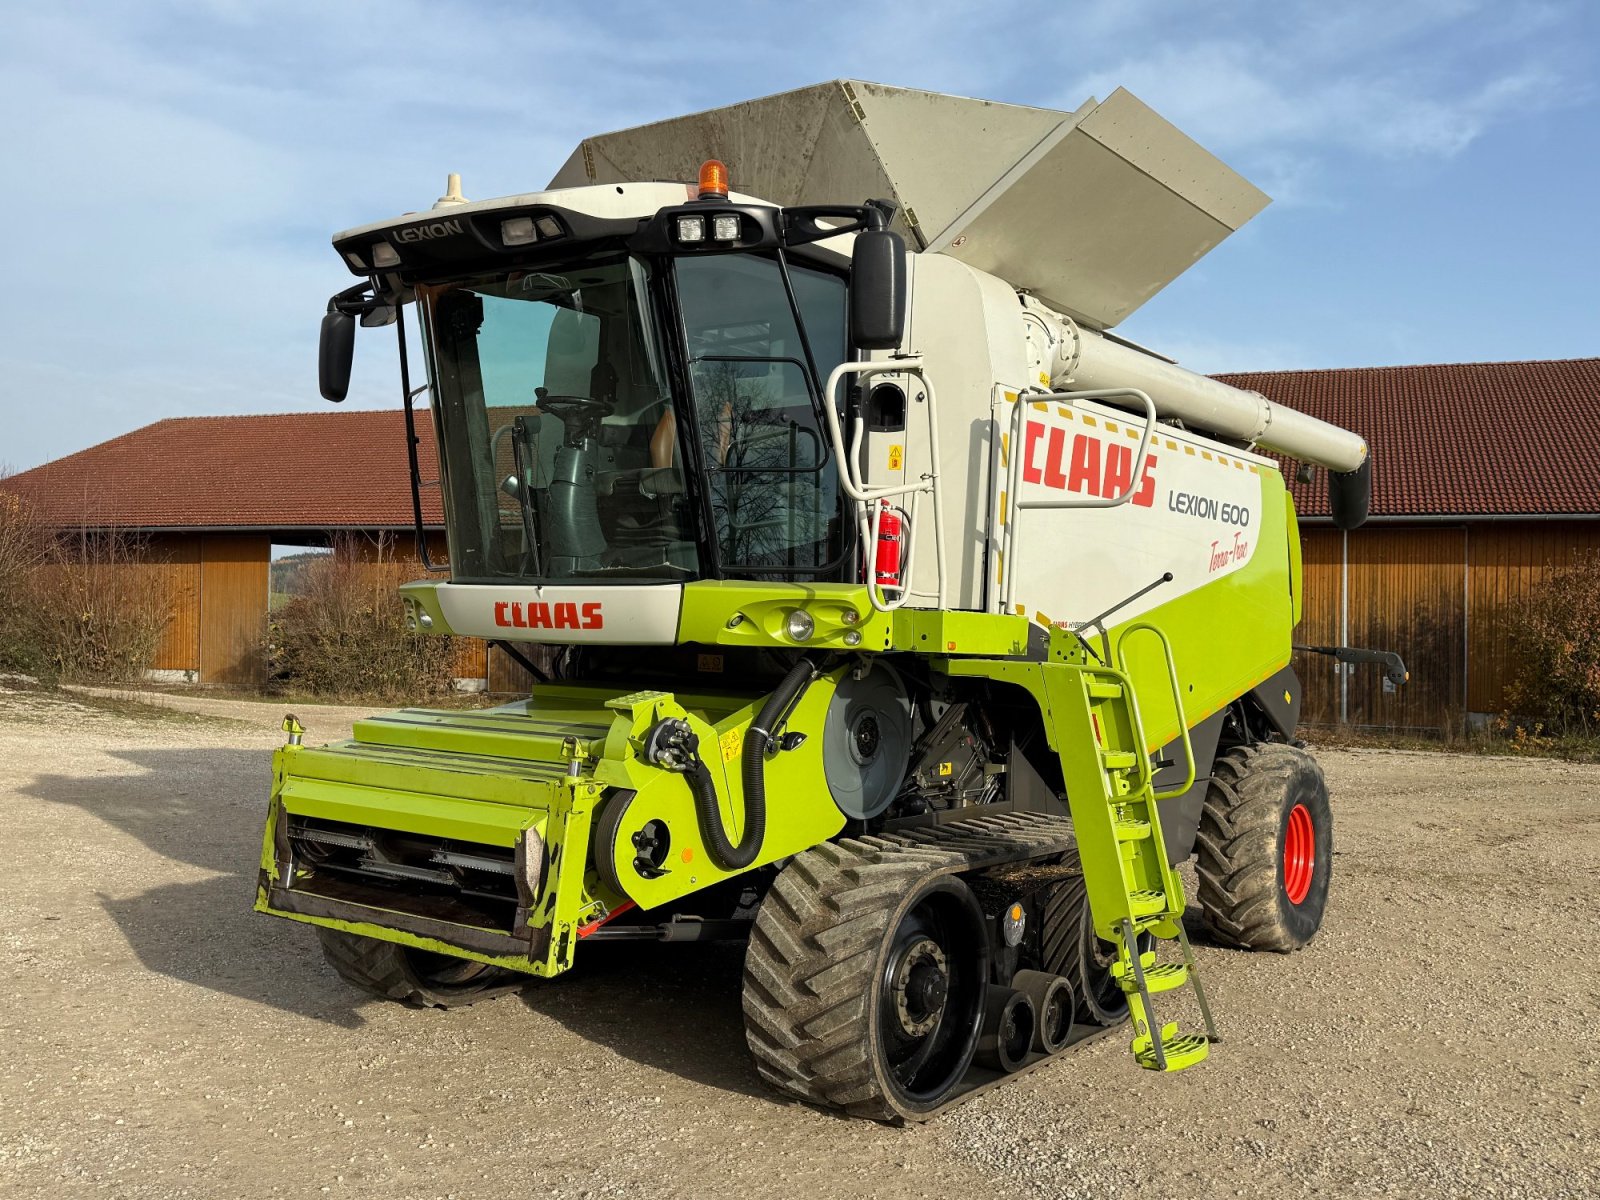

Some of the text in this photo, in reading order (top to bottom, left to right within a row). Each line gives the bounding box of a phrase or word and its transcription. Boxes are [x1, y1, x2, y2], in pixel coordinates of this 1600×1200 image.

[393, 220, 464, 243] LEXION
[1023, 420, 1158, 508] CLAAS
[1168, 490, 1250, 527] LEXION 600
[494, 601, 603, 630] CLAAS
